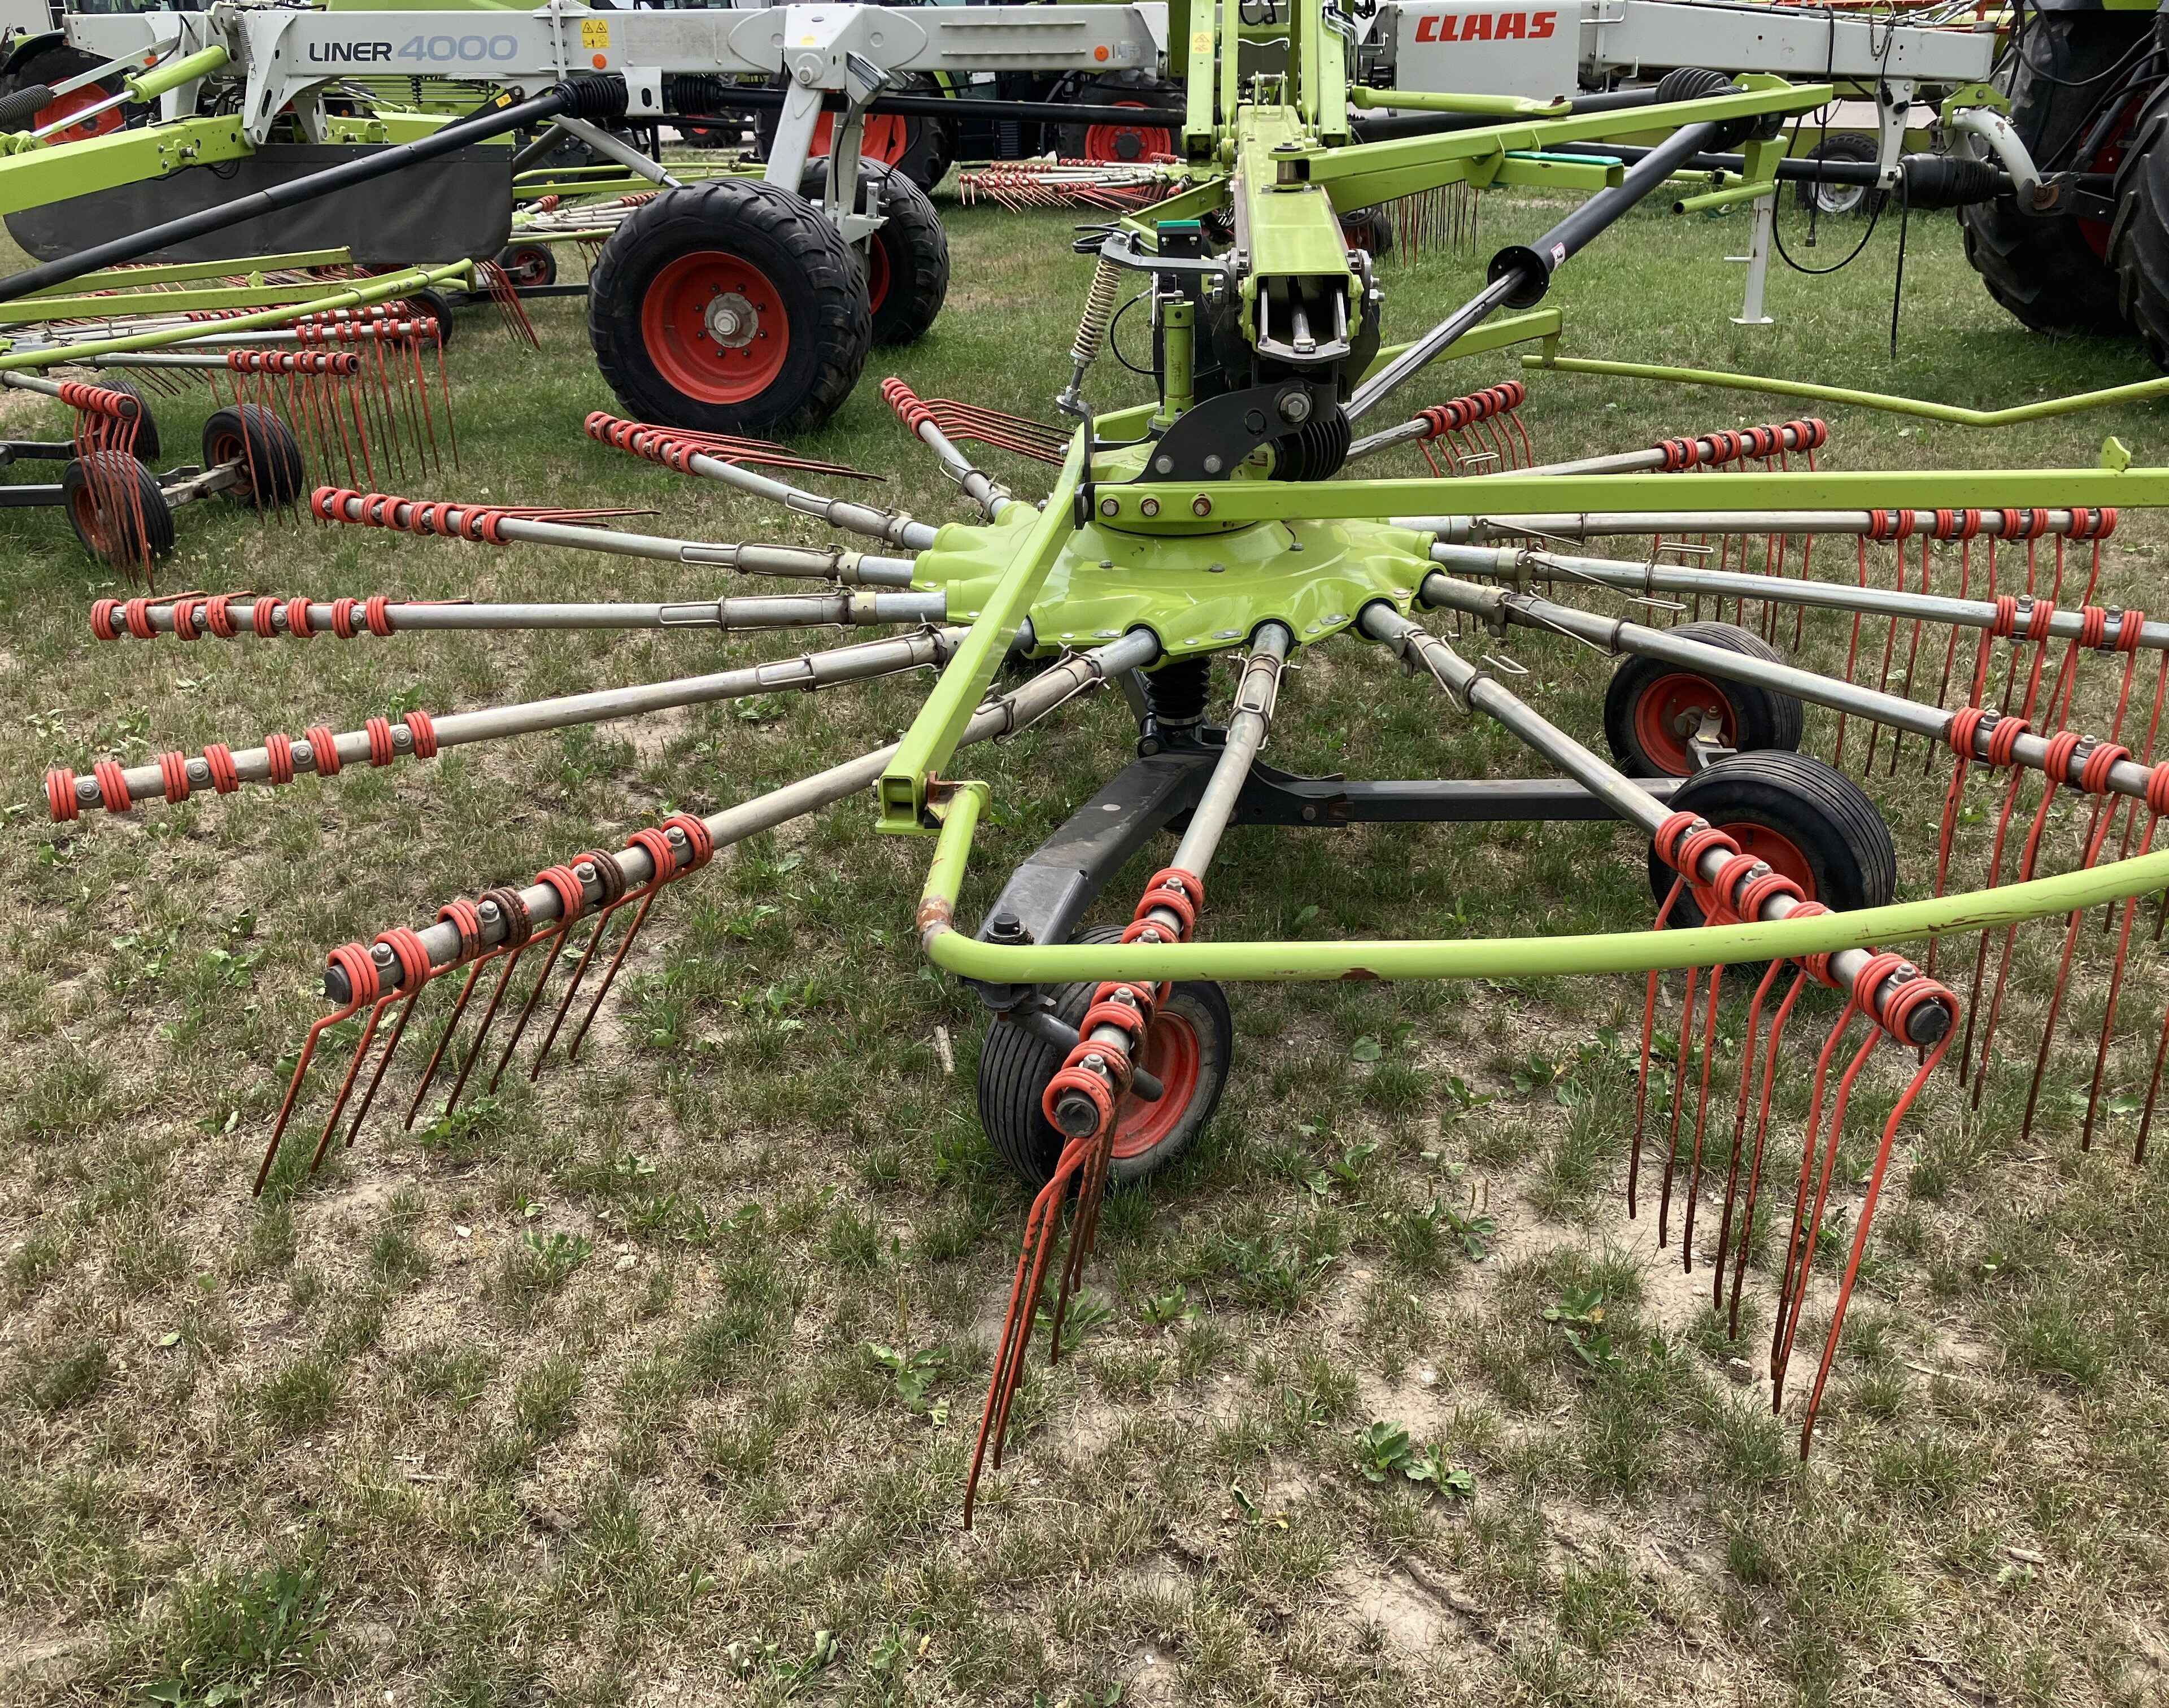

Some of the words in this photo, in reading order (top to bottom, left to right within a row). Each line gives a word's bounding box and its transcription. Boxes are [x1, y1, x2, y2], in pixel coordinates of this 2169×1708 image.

[1415, 11, 1557, 42] CLAAS
[309, 42, 393, 62] LINER
[397, 35, 519, 61] 4000
